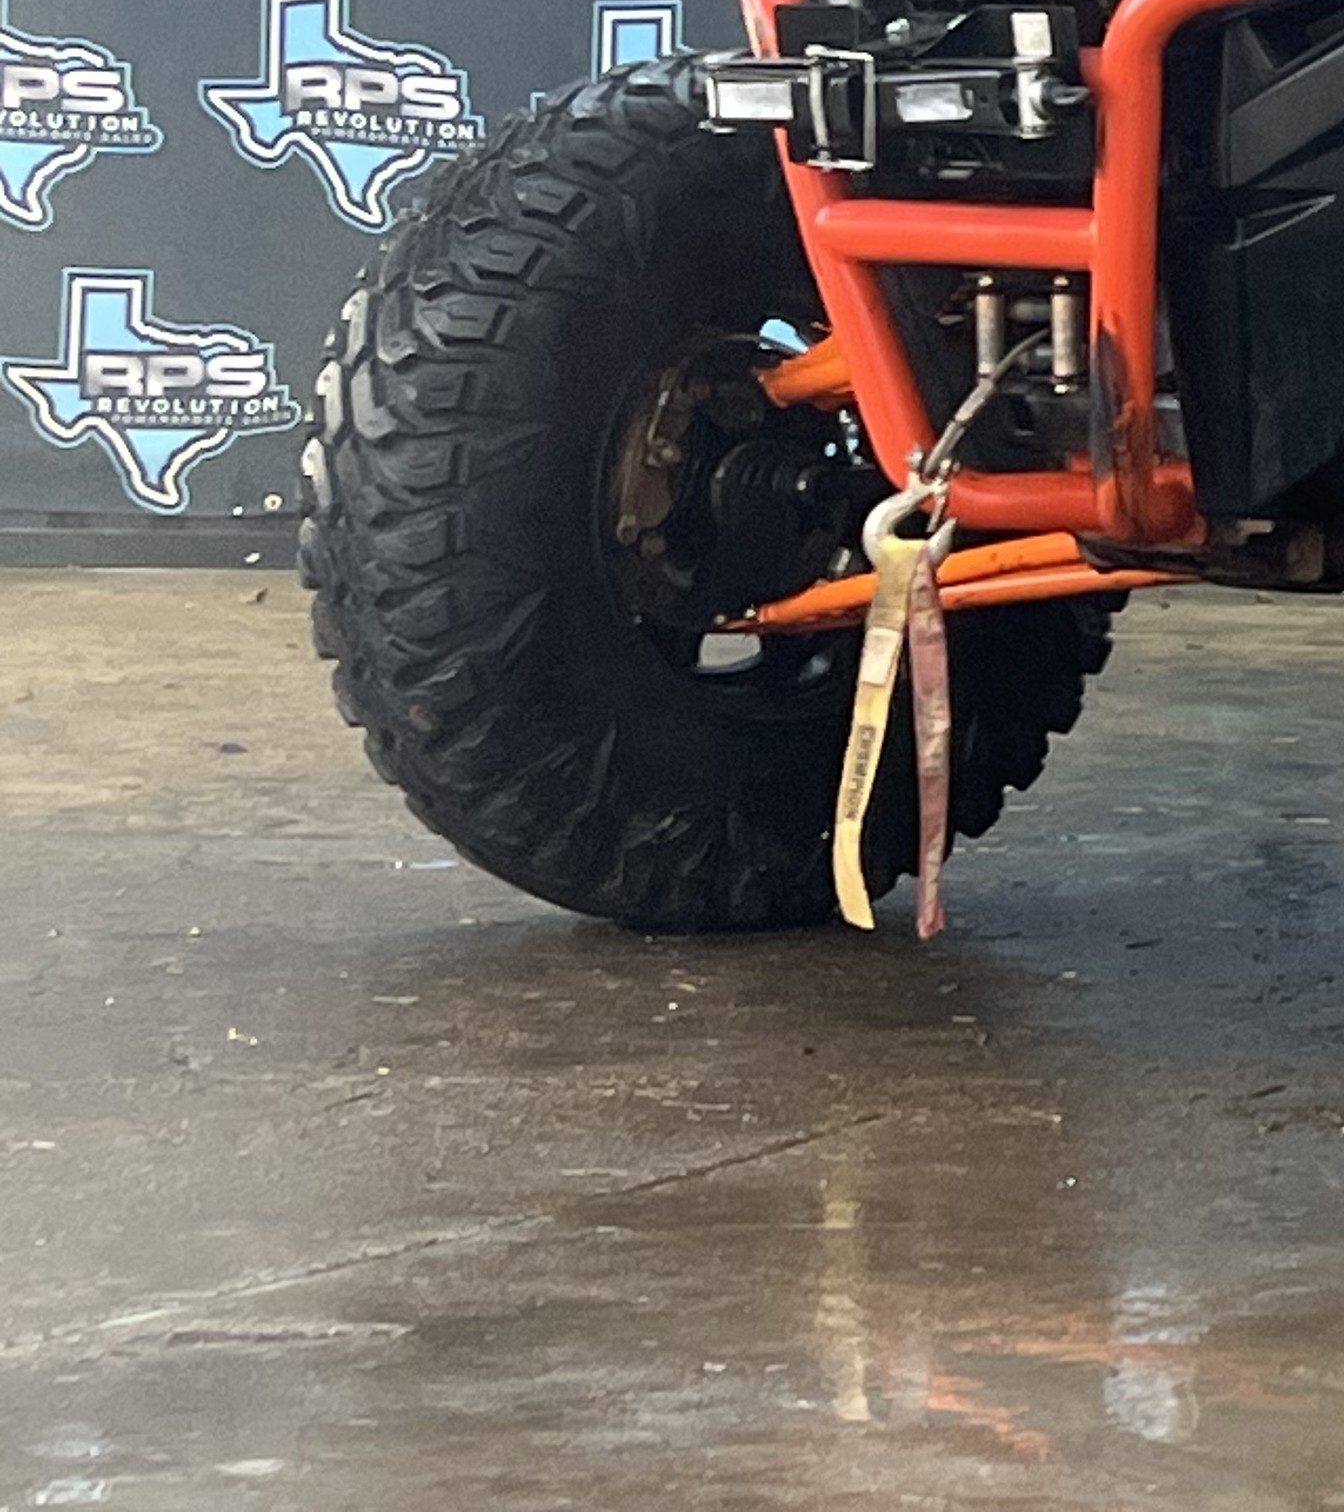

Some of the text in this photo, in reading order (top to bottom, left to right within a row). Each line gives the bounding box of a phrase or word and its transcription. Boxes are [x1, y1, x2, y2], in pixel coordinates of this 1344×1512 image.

[0, 64, 123, 116] PS
[285, 65, 459, 123] RPS
[0, 111, 138, 131] OLUTION
[297, 110, 473, 139] REVOLUTION
[85, 353, 266, 397] RPS
[96, 396, 279, 413] REVOLUTION
